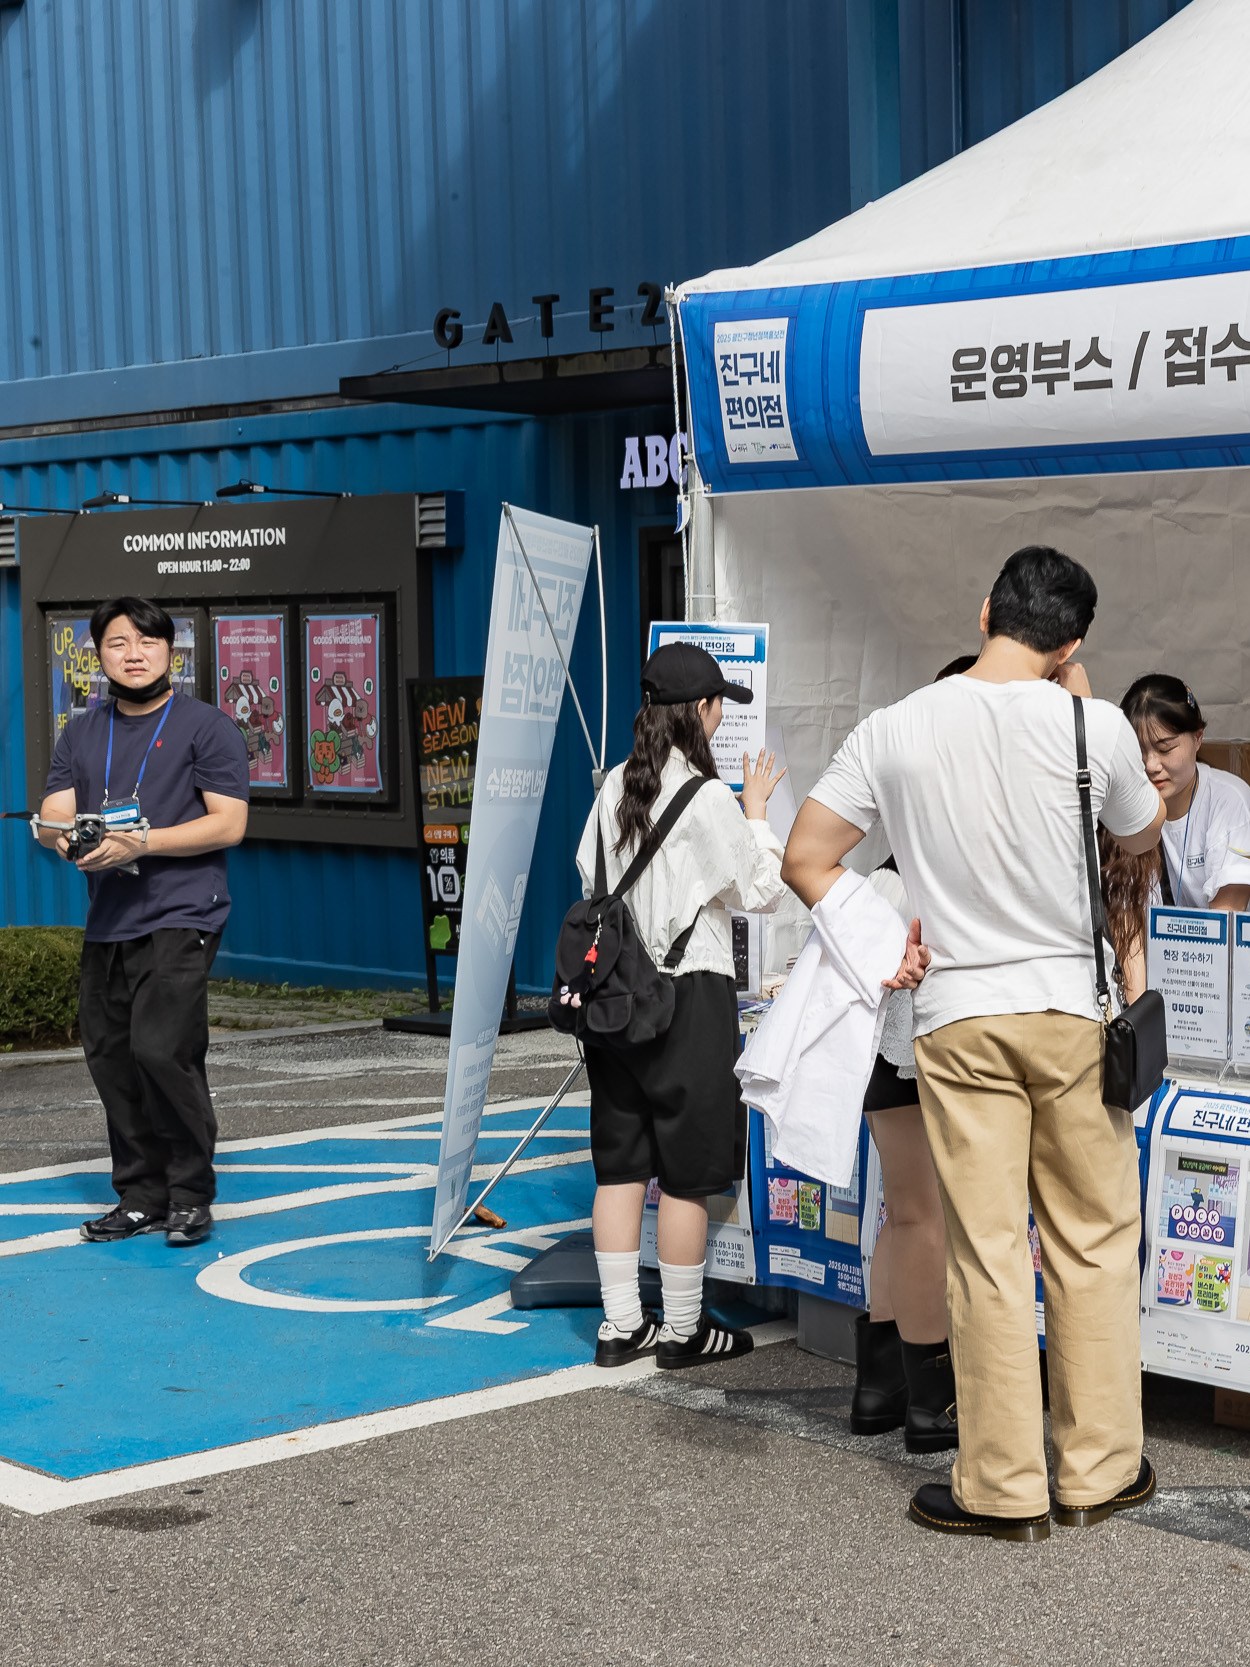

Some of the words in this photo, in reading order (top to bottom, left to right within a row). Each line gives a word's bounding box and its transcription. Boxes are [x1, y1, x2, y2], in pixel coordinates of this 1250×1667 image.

[719, 350, 781, 387] 진구네
[949, 338, 1113, 403] 운영부스
[725, 394, 785, 430] 편의점
[123, 532, 184, 552] COMMON
[187, 527, 286, 550] INFORMATION
[157, 561, 179, 574] OPEN
[179, 560, 201, 573] HOUR
[202, 559, 222, 572] 11:00
[229, 558, 251, 572] 22:00
[222, 635, 240, 645] GOODS
[240, 635, 278, 644] WONDERLAND
[313, 635, 333, 645] GOODS
[64, 661, 91, 696] Hug
[422, 699, 467, 733] NEW
[423, 721, 478, 753] SEASON
[426, 754, 470, 787] NEW
[440, 847, 456, 864] 의류
[426, 865, 461, 902] 10
[1167, 923, 1187, 934] 진구네
[1187, 925, 1208, 936] 편의점
[1163, 949, 1179, 962] 현장
[1181, 951, 1214, 964] 접수하기
[1173, 1003, 1203, 1014] EVENT
[1203, 1102, 1219, 1110] 2025
[1192, 1109, 1236, 1131] 진구네
[1172, 1207, 1217, 1223] PICK
